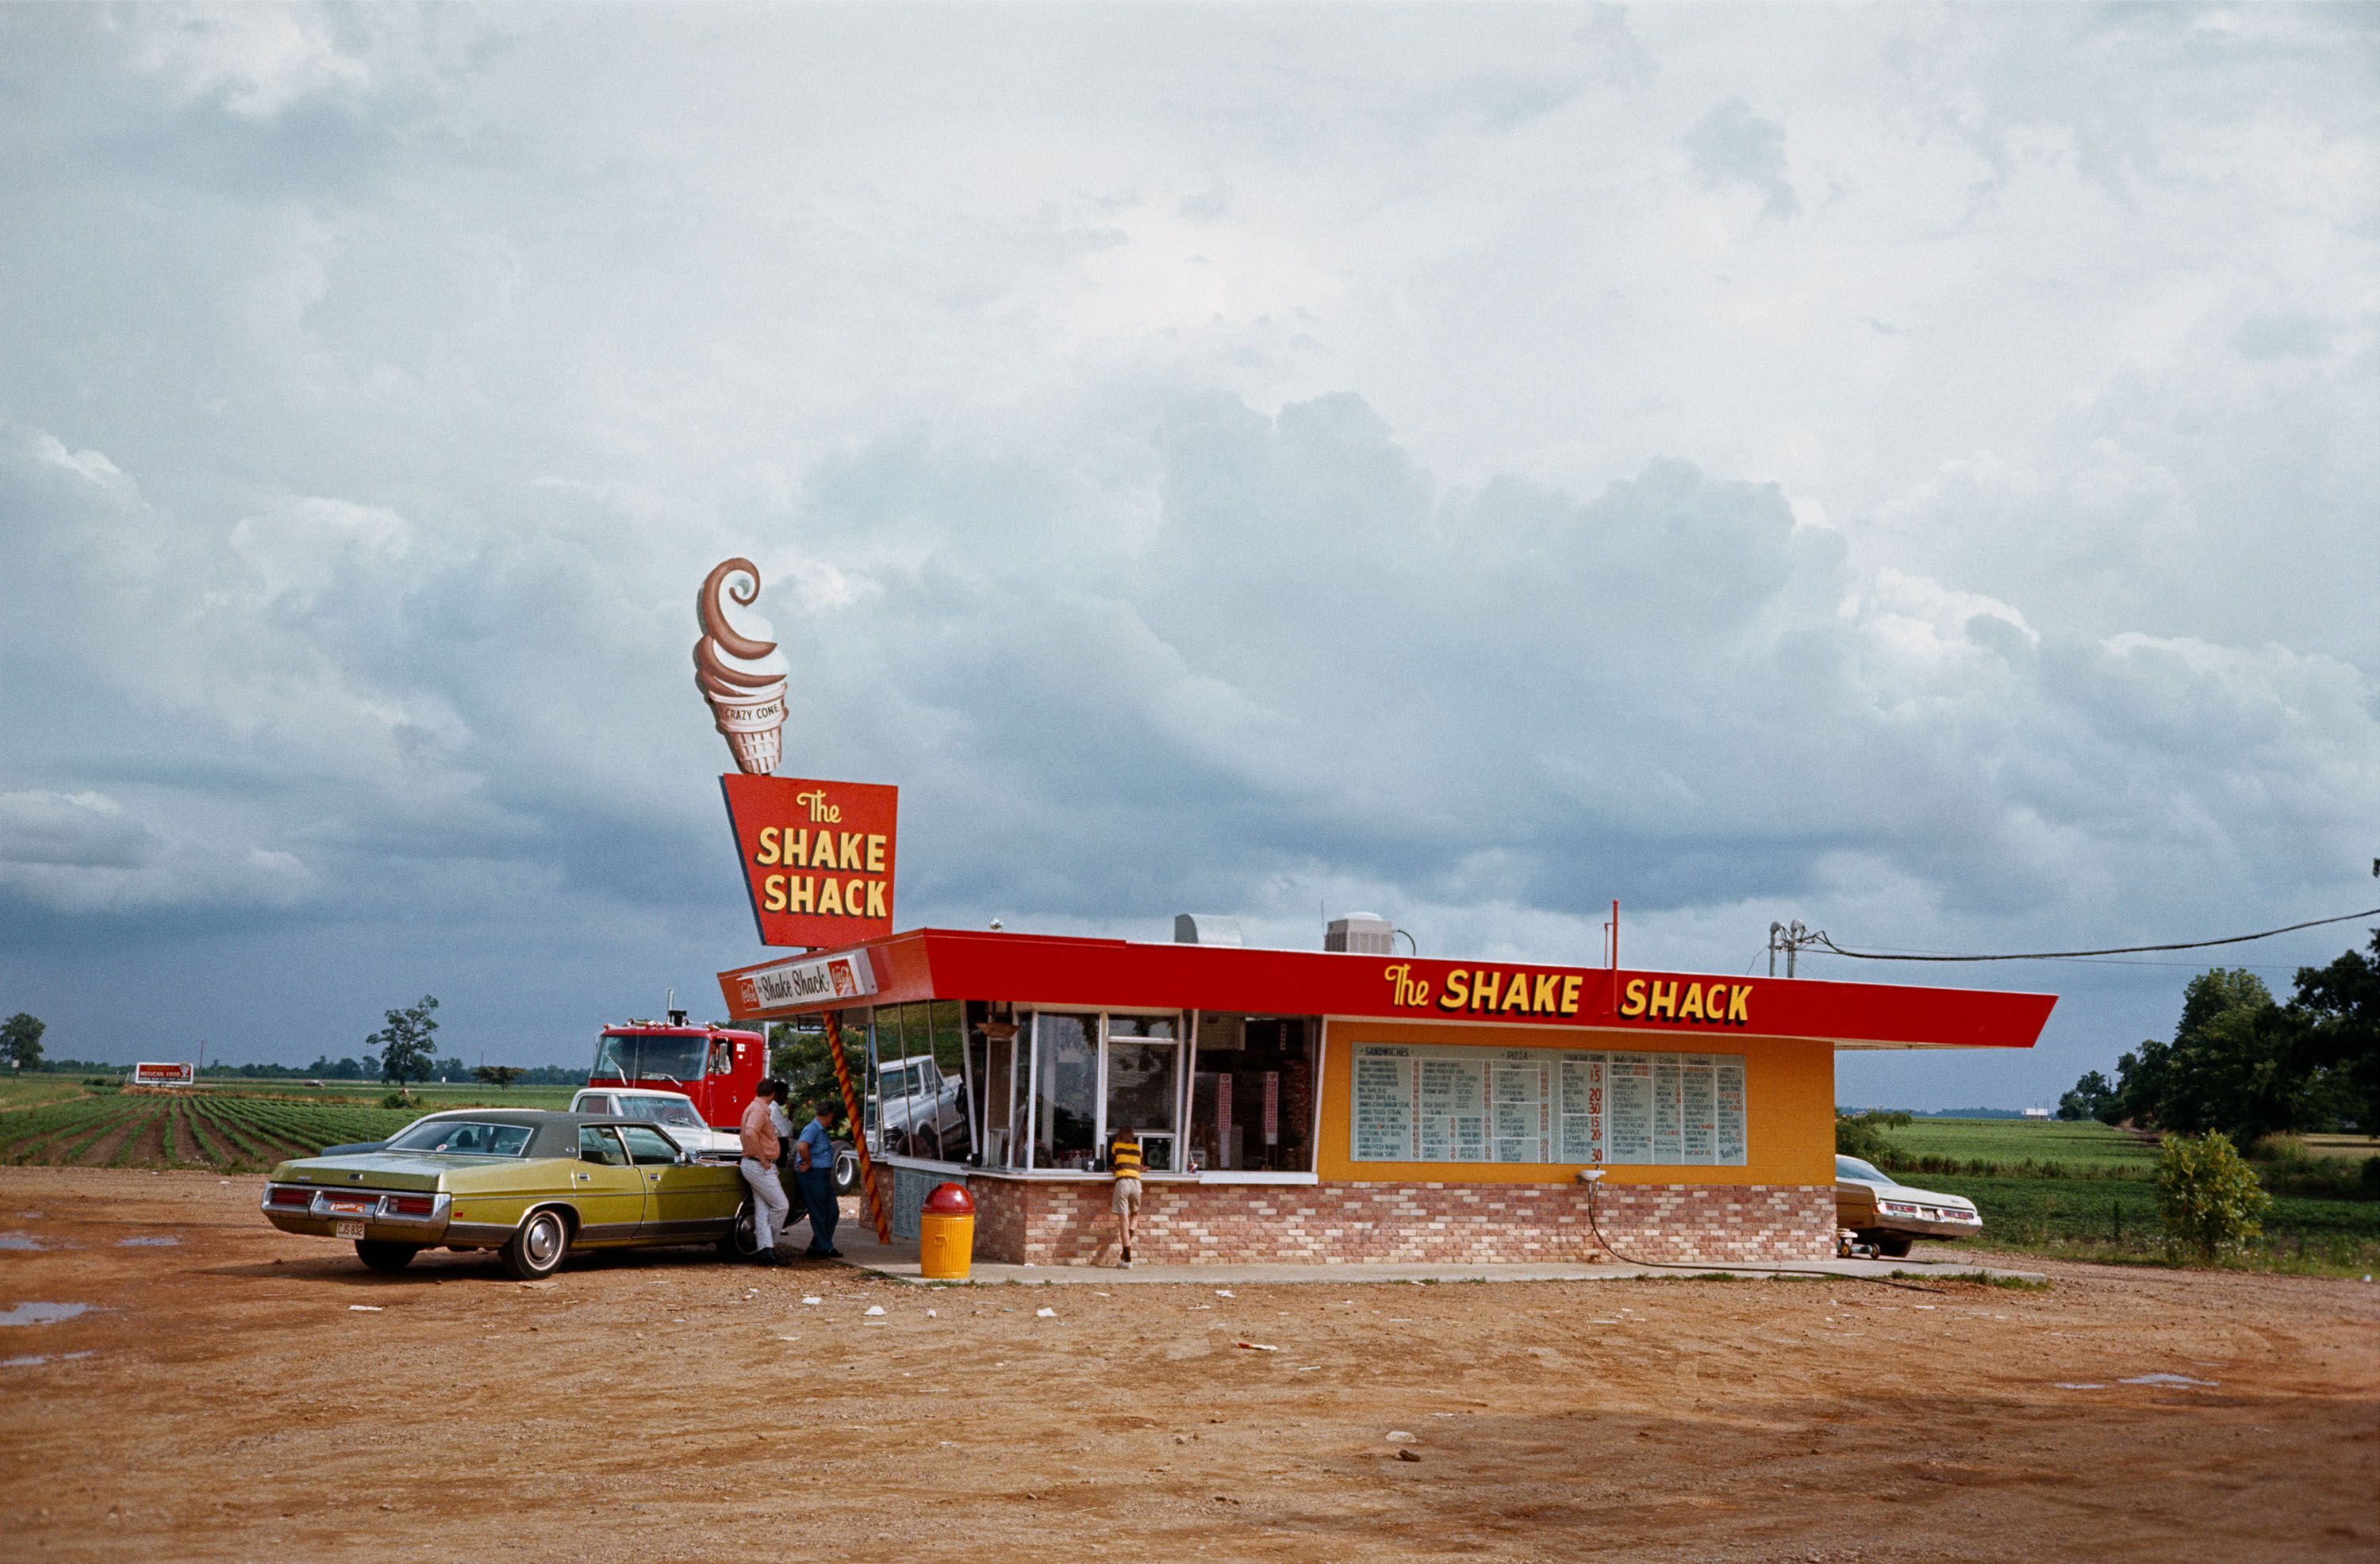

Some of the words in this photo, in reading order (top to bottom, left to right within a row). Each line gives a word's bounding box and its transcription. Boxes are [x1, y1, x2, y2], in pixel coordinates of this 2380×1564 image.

[725, 707, 753, 720] CRAZY
[756, 704, 780, 719] CONE
[796, 789, 842, 824] The
[756, 826, 887, 872] SHAKE
[764, 874, 887, 918] SHACK
[761, 974, 793, 1002] Shake
[792, 966, 830, 997] Shack
[1384, 963, 1430, 1006] The
[1440, 968, 1583, 1014] SHAKE
[1620, 977, 1753, 1022] SHACK
[1365, 1047, 1410, 1056] SANDWICHES
[1507, 1051, 1529, 1060] PIZZA
[1591, 1069, 1600, 1083] 15
[1589, 1087, 1603, 1102] 20
[1588, 1102, 1601, 1114] 30
[1591, 1117, 1599, 1128] 15
[1591, 1148, 1602, 1162] 30
